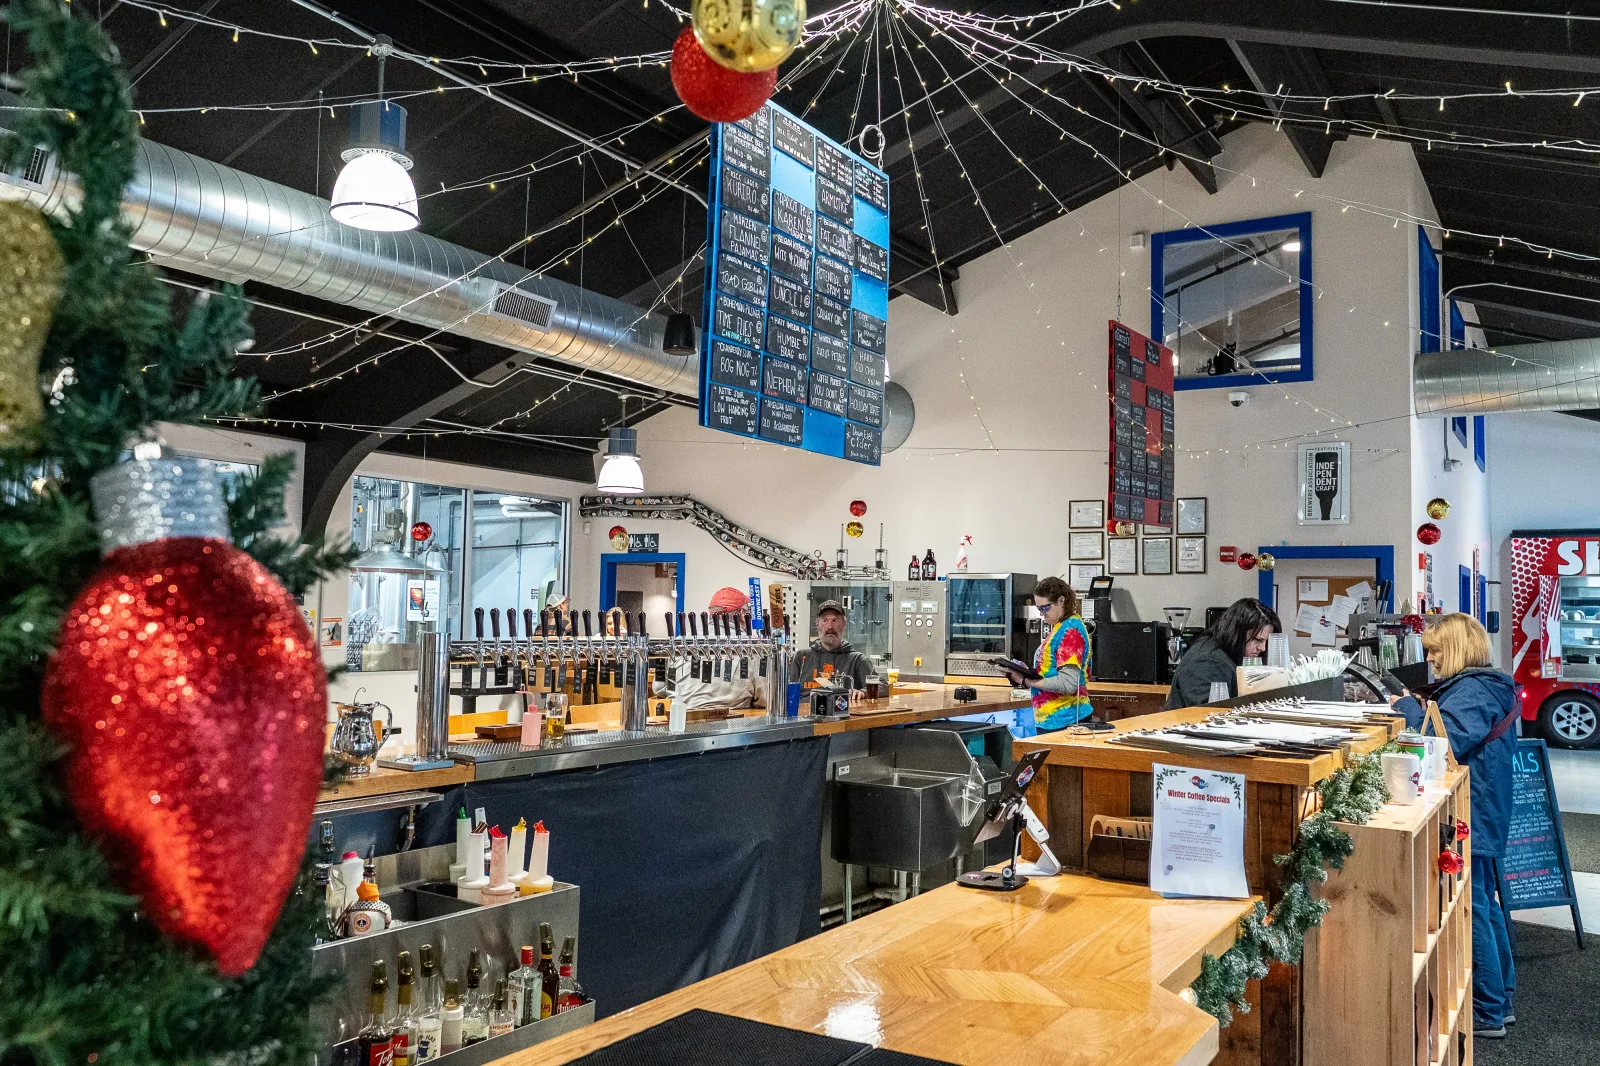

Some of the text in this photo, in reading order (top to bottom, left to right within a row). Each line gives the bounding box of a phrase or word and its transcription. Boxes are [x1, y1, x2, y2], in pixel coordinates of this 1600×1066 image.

[733, 213, 757, 232] MARZEN
[778, 207, 804, 233] KAREN
[730, 225, 763, 252] FLANNEL
[820, 227, 830, 241] FAT
[731, 241, 758, 262] PAJAMAS
[721, 270, 739, 287] TOAD
[826, 283, 841, 299] SPAM
[718, 309, 753, 337] TIME FLIES
[777, 330, 801, 349] HUMBLE
[780, 345, 794, 359] BRAG
[831, 350, 846, 363] PETALS
[721, 356, 734, 373] BOG
[736, 360, 750, 377] NOG
[766, 369, 796, 396] NEPHEW
[816, 373, 829, 383] COFFEE
[813, 384, 825, 396] YOU
[714, 401, 748, 417] LOW HANGING
[810, 396, 823, 407] VOTE
[824, 400, 832, 409] FOR
[833, 403, 844, 413] KINGS
[720, 416, 733, 424] FRUIT
[762, 417, 770, 428] OLD
[852, 427, 863, 437] Down
[850, 436, 871, 450] Cider
[1316, 462, 1335, 470] INDE
[1512, 752, 1539, 773] ALS
[1168, 789, 1230, 804] Winter Coffee Specials
